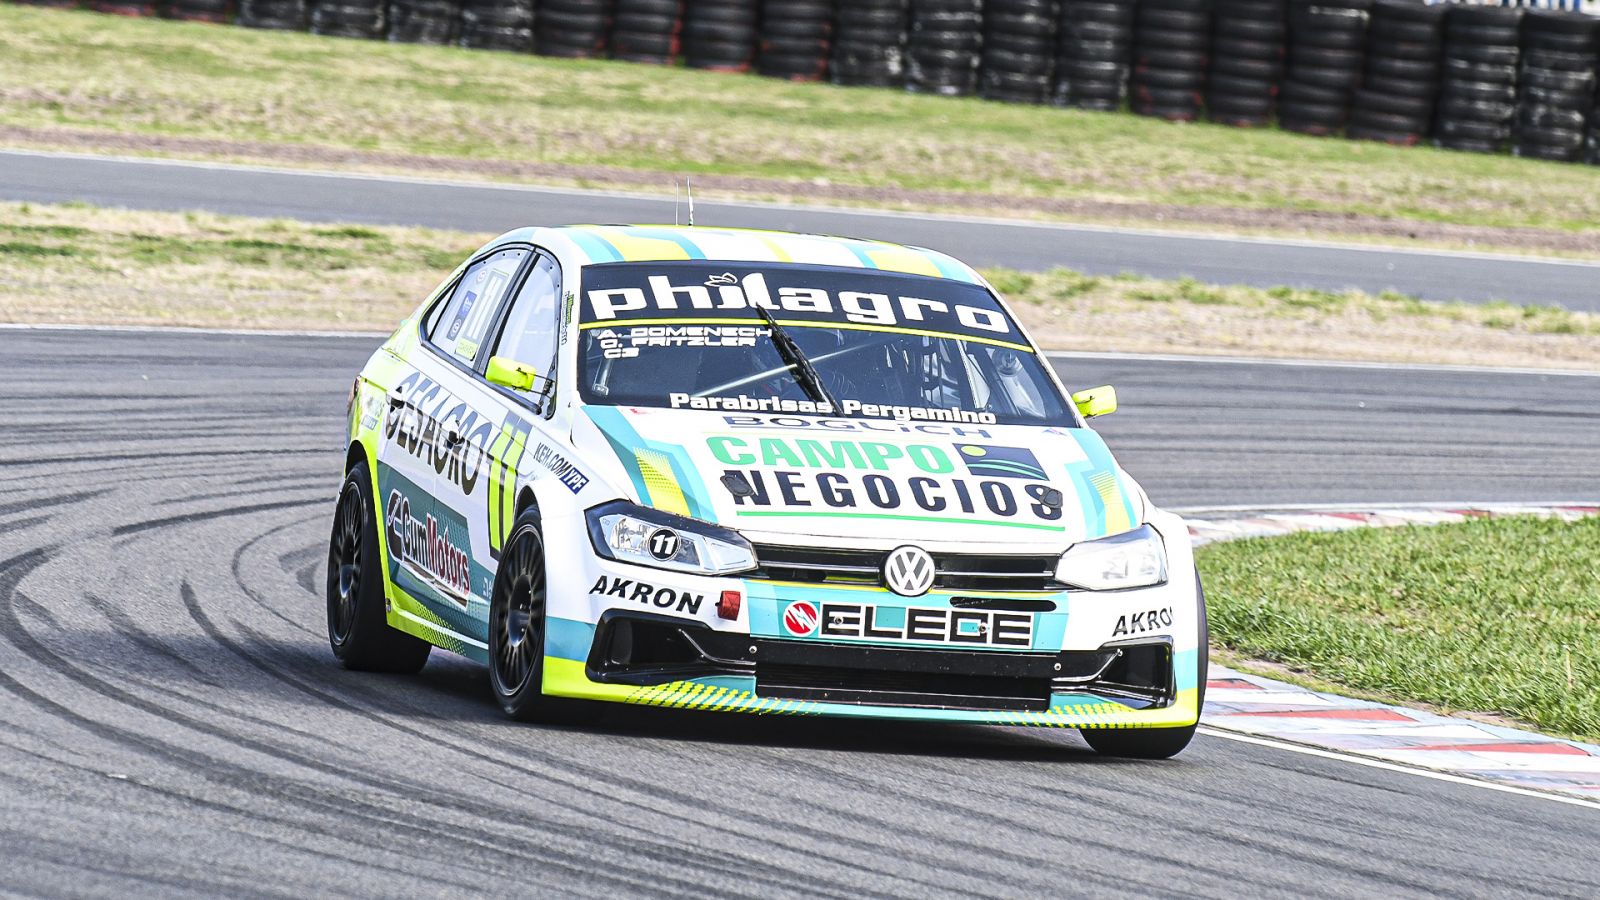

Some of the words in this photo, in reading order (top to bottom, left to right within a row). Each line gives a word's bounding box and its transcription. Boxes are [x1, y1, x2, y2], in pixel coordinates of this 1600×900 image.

[587, 273, 1009, 333] philagro
[597, 329, 622, 340] A.
[631, 327, 772, 337] DOMENECH
[631, 337, 756, 347] FRITZLER
[669, 393, 833, 414] Parabrisas
[842, 400, 996, 425] Pergamino
[706, 436, 955, 474] CAMPO
[564, 467, 586, 491] YPF
[723, 470, 1064, 520] NEGOCIOS
[652, 533, 679, 556] 11
[589, 575, 704, 615] AKRON
